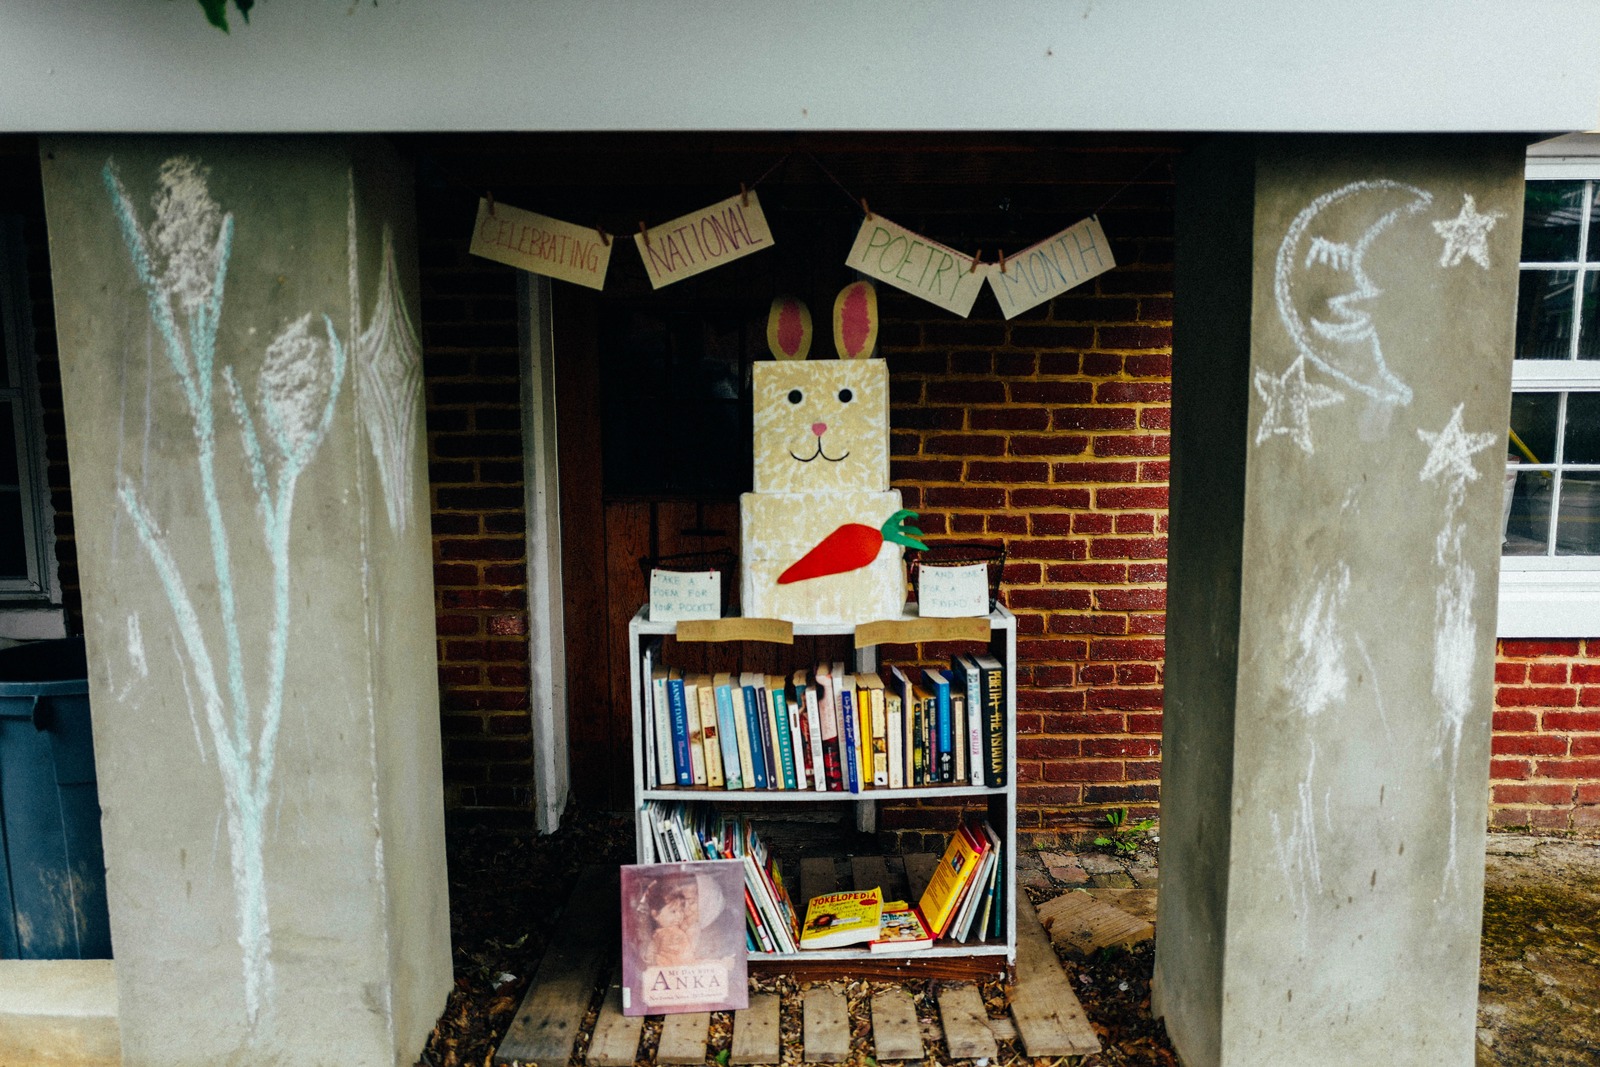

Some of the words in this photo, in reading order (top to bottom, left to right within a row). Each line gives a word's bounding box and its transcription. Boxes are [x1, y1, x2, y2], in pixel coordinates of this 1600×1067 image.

[481, 216, 601, 273] CELEBRATING
[647, 203, 762, 278] NATIONAL
[861, 226, 973, 302] POETRY
[1002, 225, 1104, 307] MONTH
[671, 682, 682, 706] JANET
[675, 707, 684, 736] DAILEY
[650, 969, 722, 992] ANKA
